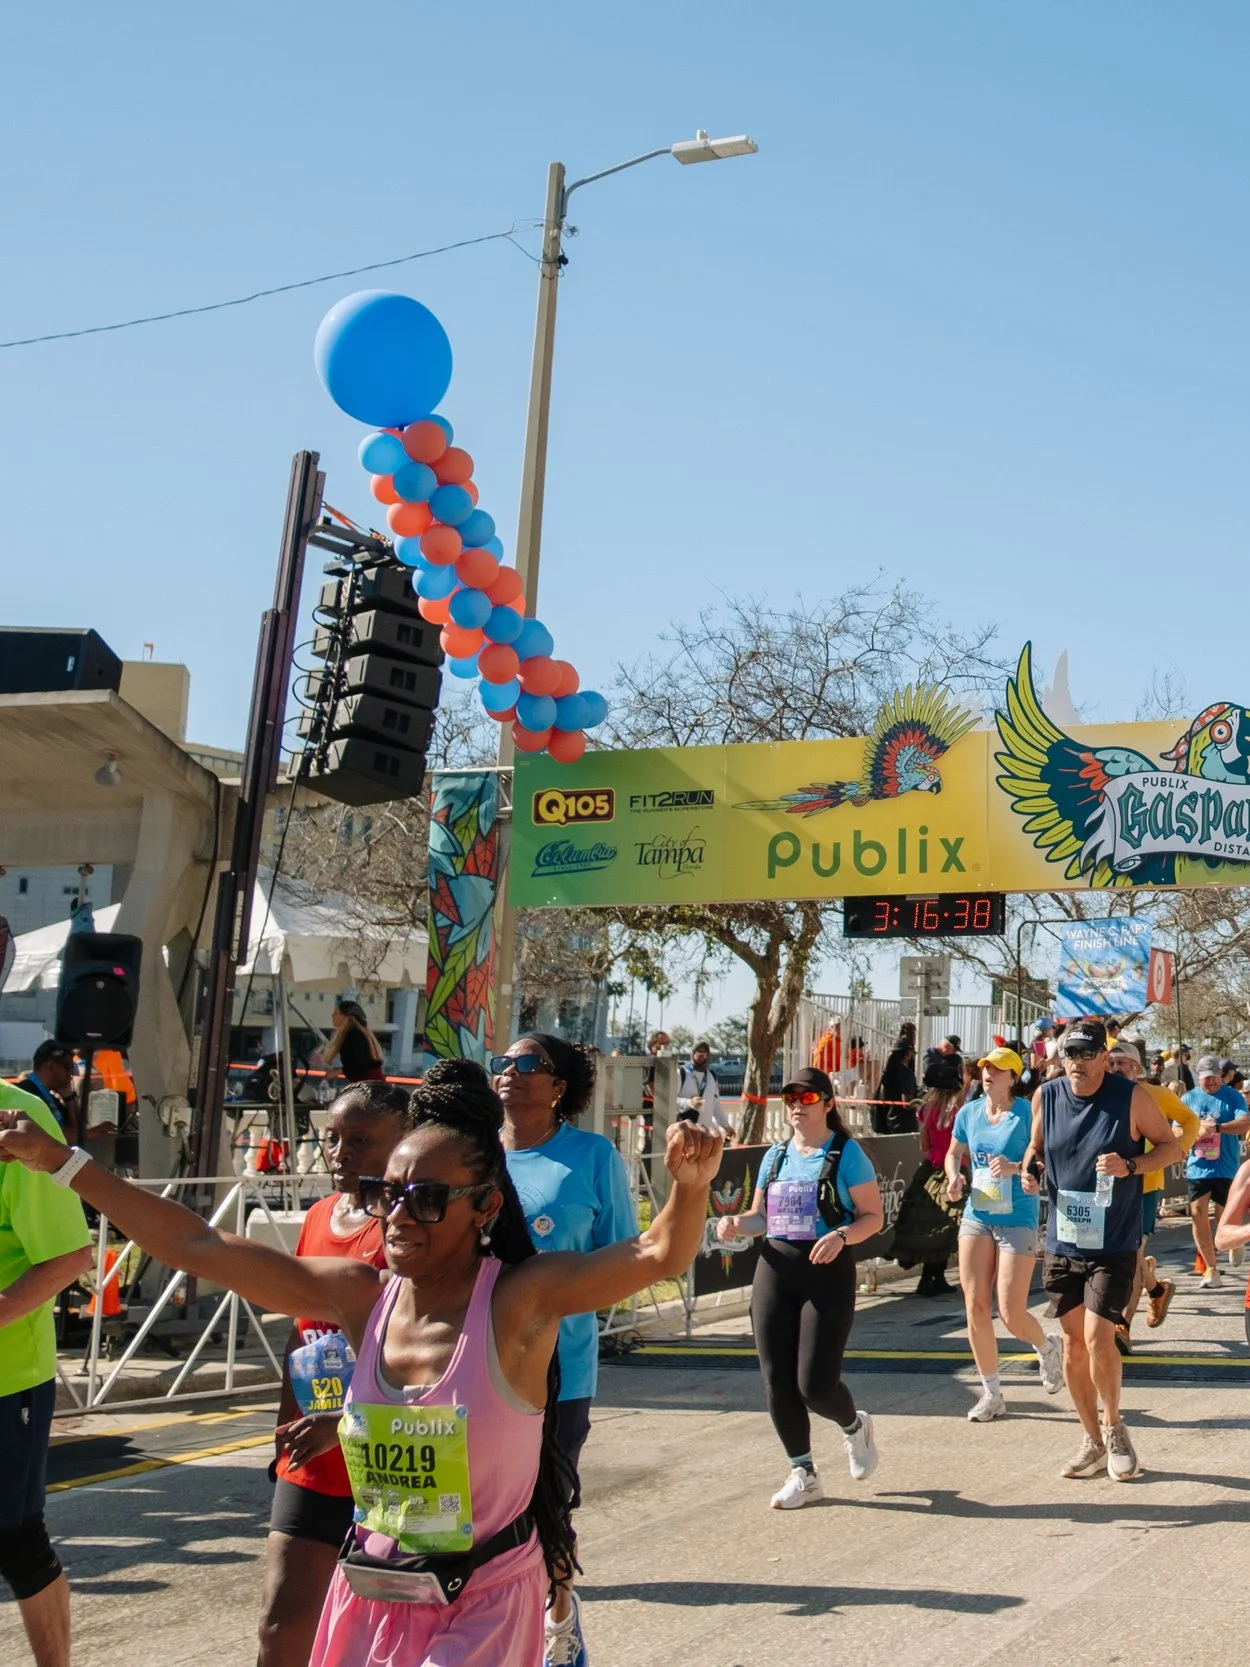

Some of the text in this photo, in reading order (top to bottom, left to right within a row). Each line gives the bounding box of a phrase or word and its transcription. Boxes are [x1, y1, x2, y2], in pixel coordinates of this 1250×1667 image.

[1142, 777, 1189, 790] PUBLIX
[538, 790, 610, 823] Q105
[630, 790, 715, 808] FIT2RUN
[651, 833, 676, 848] City
[634, 842, 704, 872] Tampa
[767, 825, 967, 878] Publix
[1066, 927, 1105, 940] WAYNE
[1120, 923, 1149, 936] PAPY
[1073, 936, 1138, 950] FINISH LINE
[788, 1185, 814, 1193] Publix
[1066, 1205, 1090, 1218] 6305
[311, 1377, 344, 1398] 620
[391, 1417, 455, 1435] Publix
[362, 1443, 437, 1472] 10219
[366, 1470, 438, 1490] ANDREA
